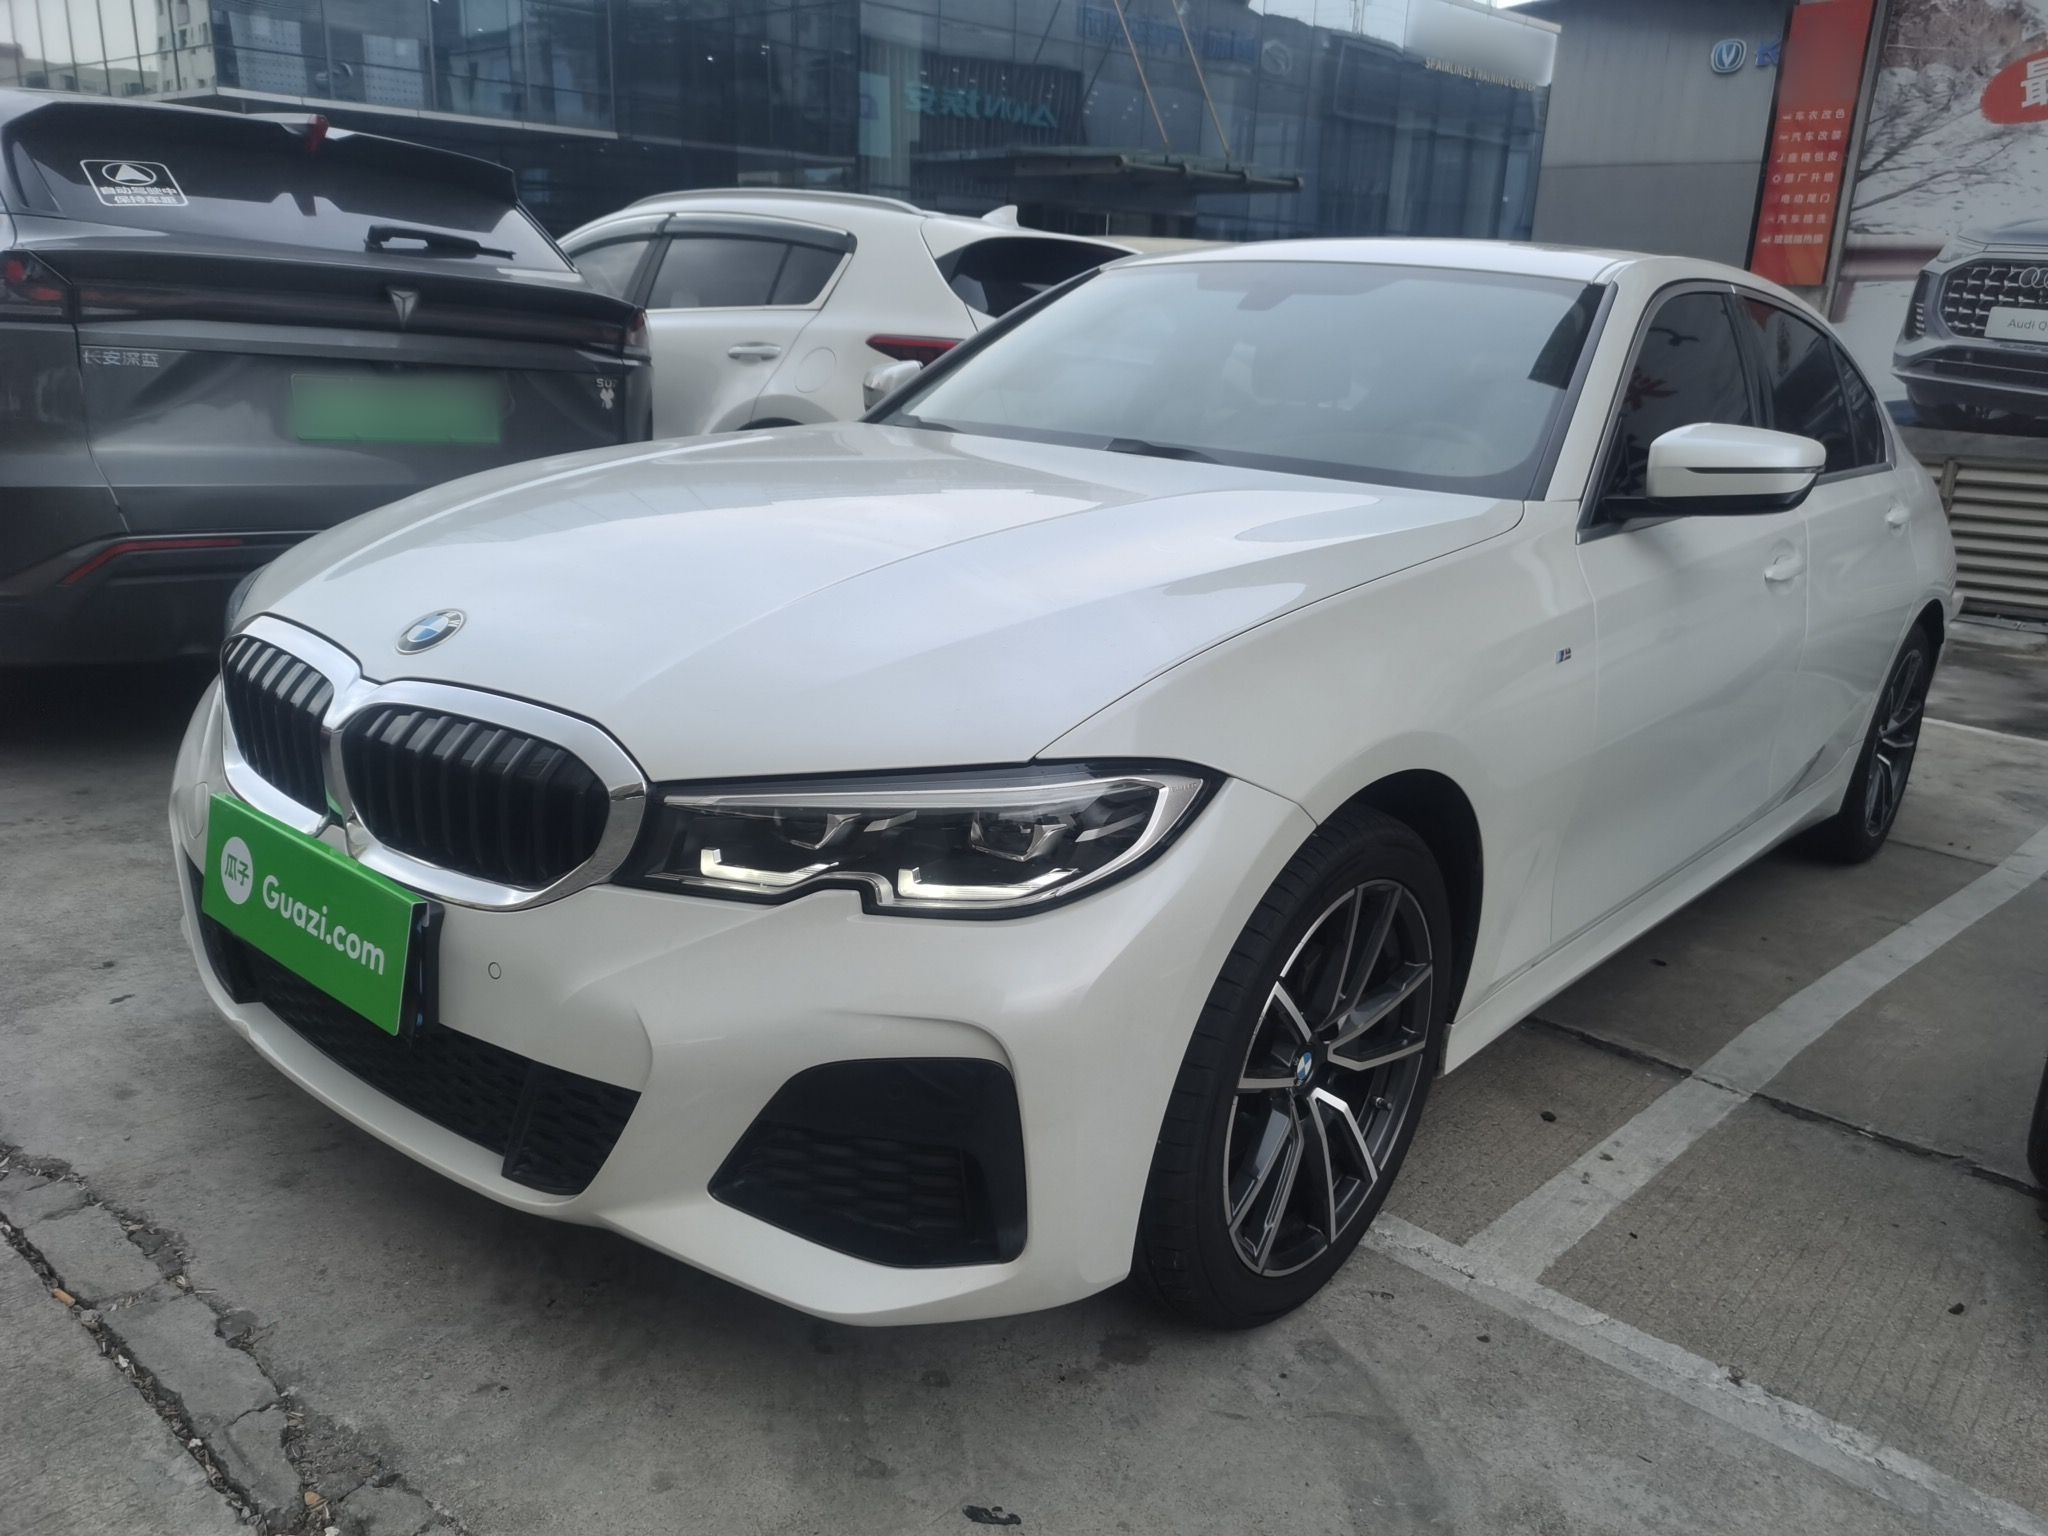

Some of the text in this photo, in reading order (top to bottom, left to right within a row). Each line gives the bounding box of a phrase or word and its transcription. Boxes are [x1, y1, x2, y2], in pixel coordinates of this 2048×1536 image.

[1435, 60, 1471, 79] AIRLINES
[1795, 109, 1845, 120] 车衣改色
[2008, 319, 2034, 330] Audi
[82, 350, 160, 368] 长安深蓝
[224, 853, 250, 886] 瓜子
[262, 874, 385, 976] Guazi.com
